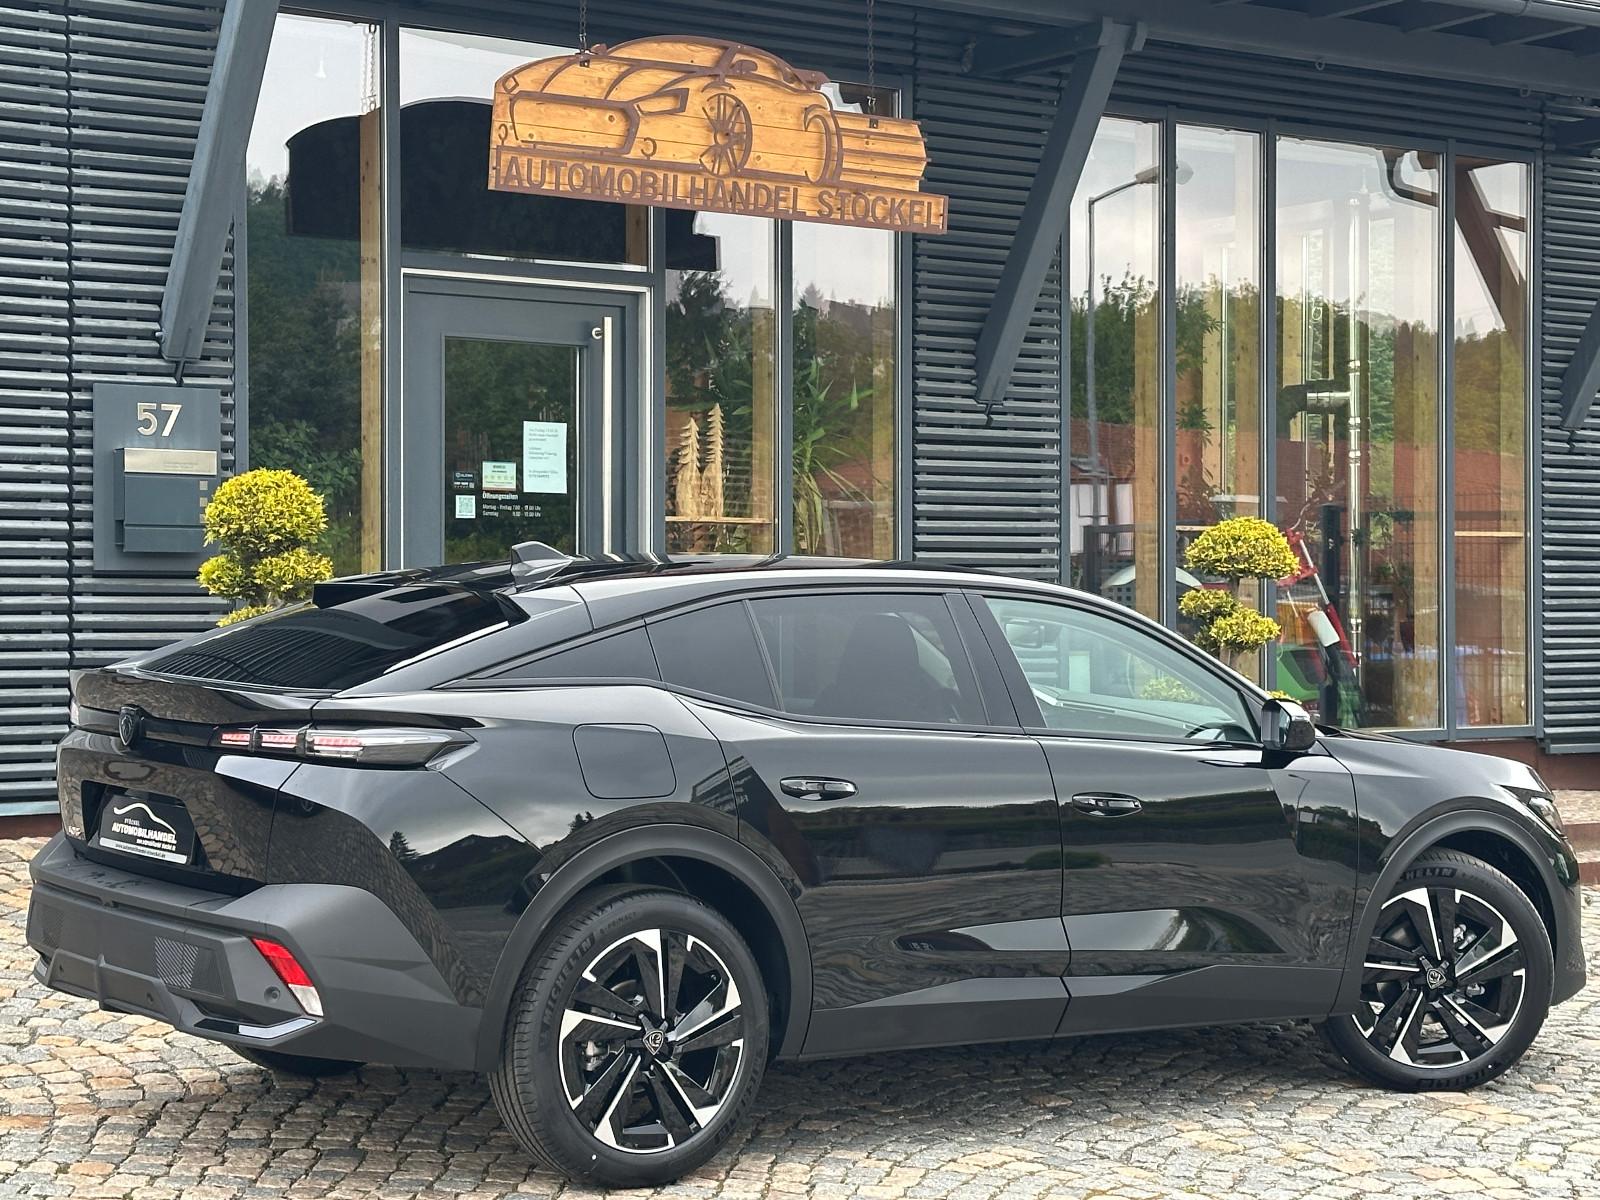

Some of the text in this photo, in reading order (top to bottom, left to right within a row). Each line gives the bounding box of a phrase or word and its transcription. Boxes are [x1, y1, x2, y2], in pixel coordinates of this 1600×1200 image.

[503, 156, 806, 215] AUTOMOBILHANDEL
[137, 402, 182, 437] 57
[112, 822, 177, 844] AUTOMOBILHANDEL
[543, 936, 593, 1027] MICHELIN
